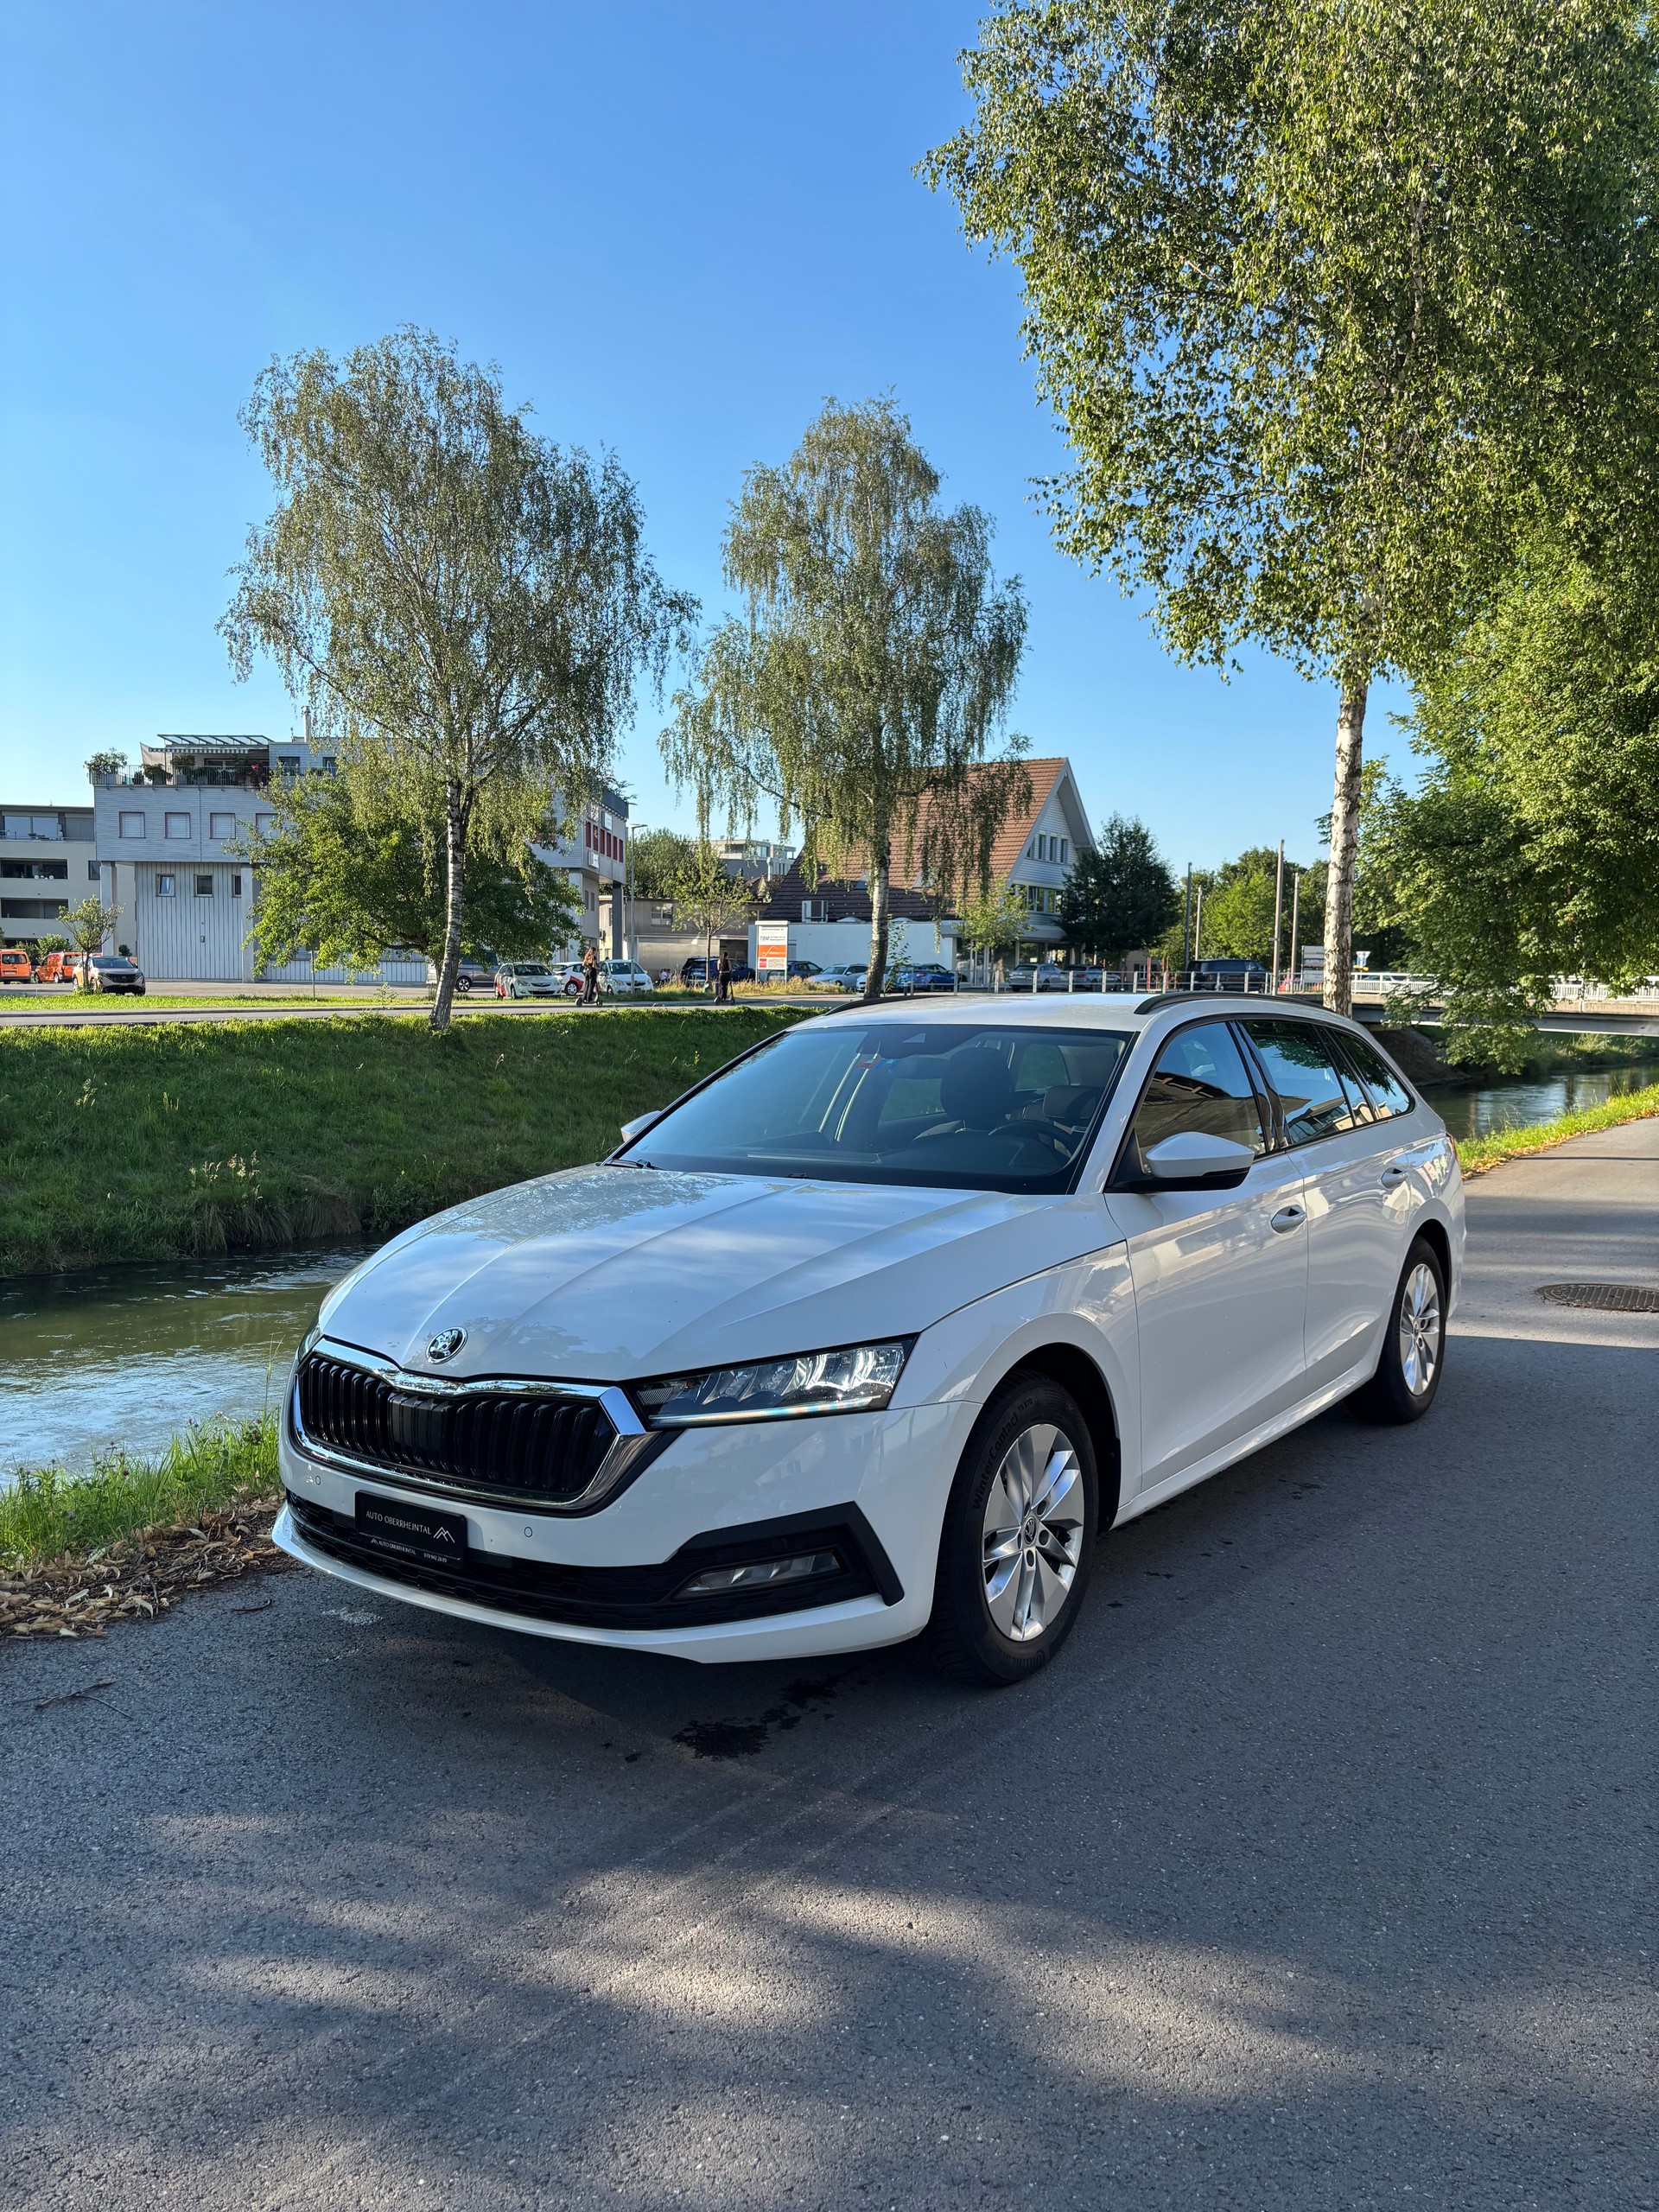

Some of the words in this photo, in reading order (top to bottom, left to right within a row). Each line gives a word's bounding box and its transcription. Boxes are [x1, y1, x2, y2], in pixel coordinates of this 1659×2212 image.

[1024, 1397, 1033, 1408] 870
[972, 1412, 1020, 1509] WinterContact
[365, 1510, 383, 1522] AUTO
[384, 1515, 431, 1535] OBERRHEINTAL
